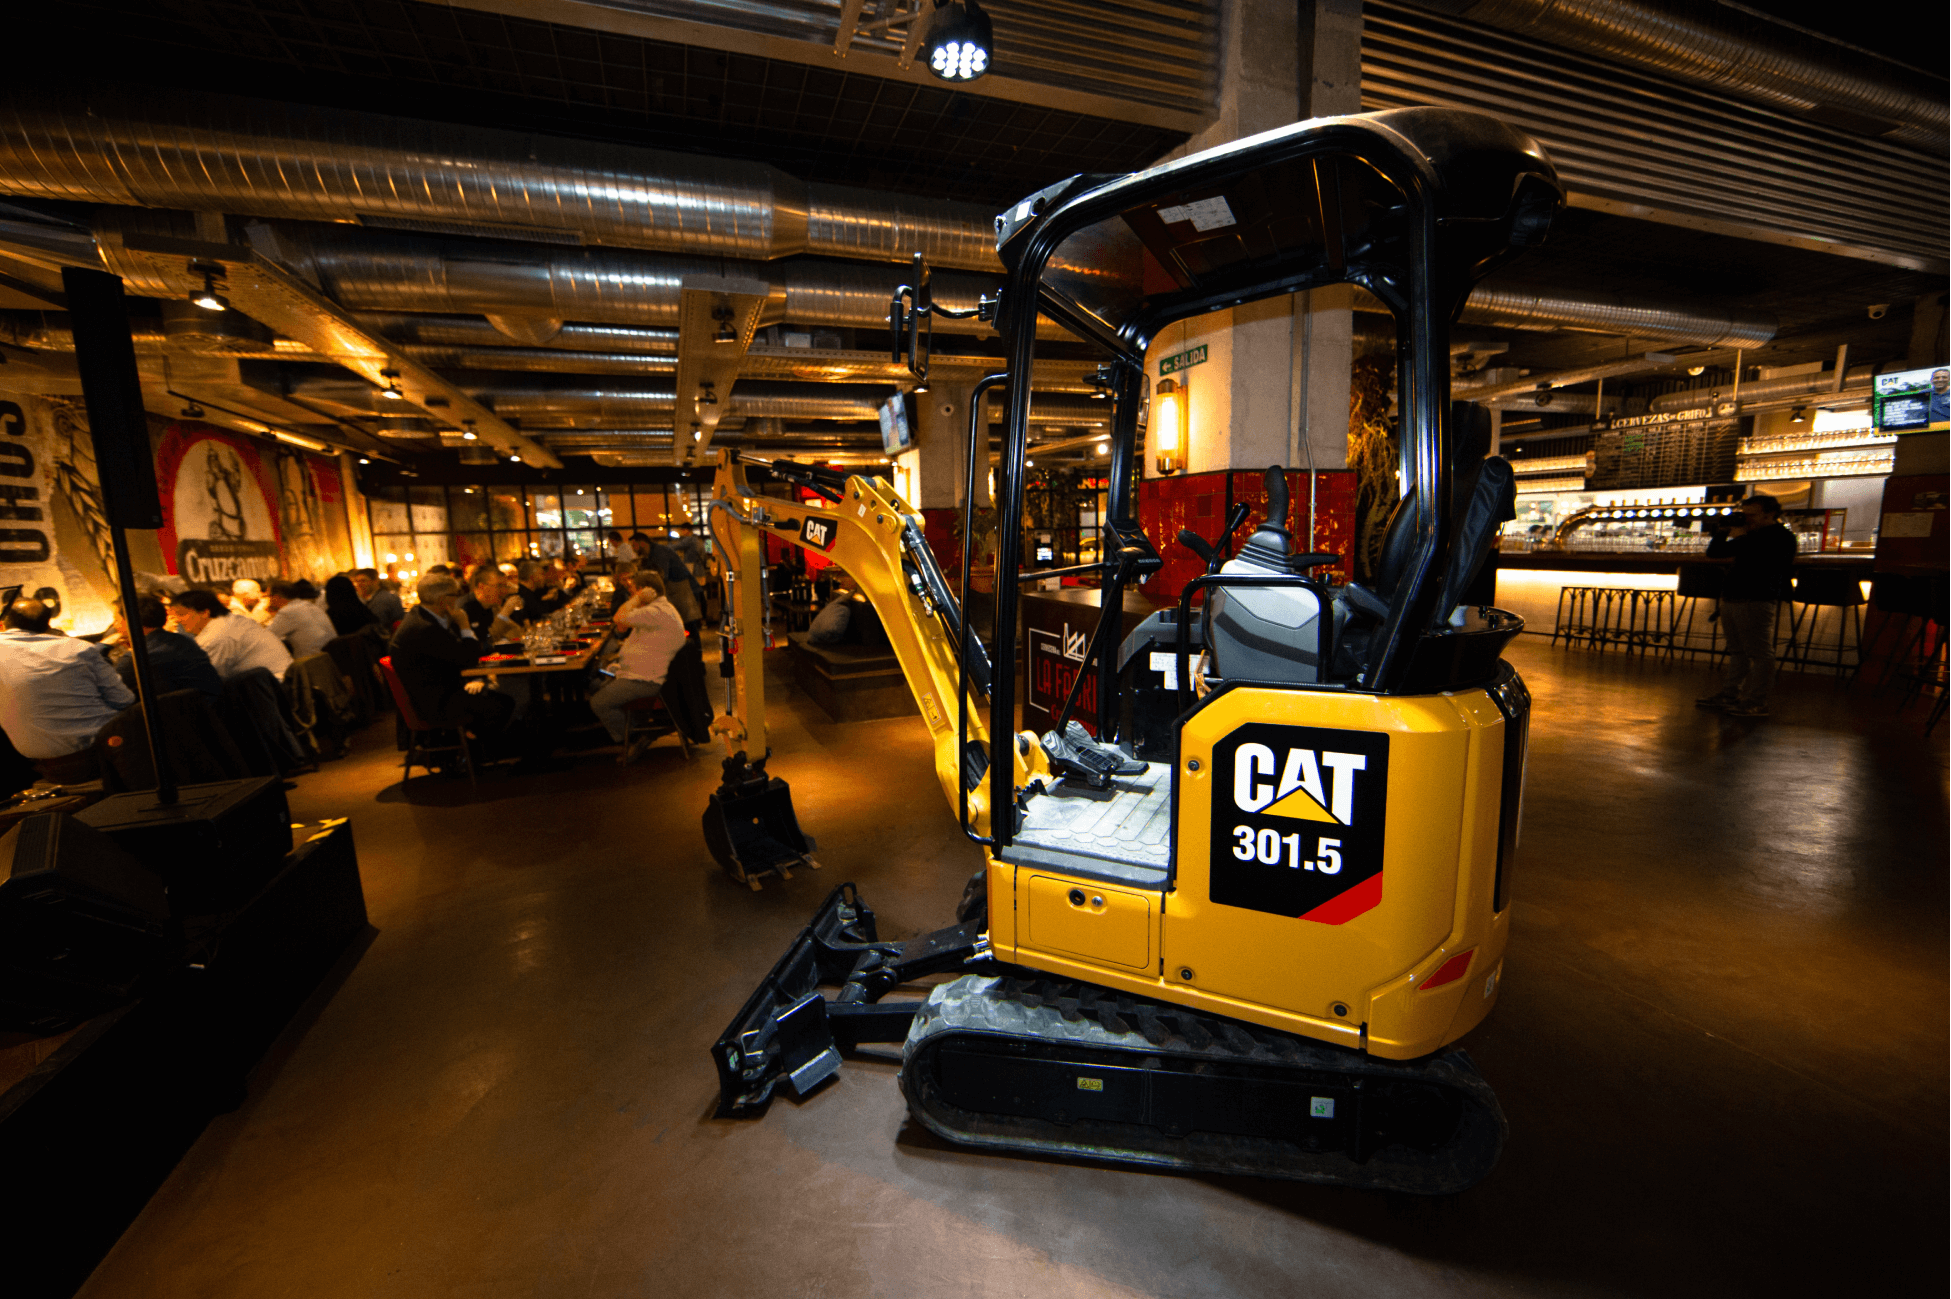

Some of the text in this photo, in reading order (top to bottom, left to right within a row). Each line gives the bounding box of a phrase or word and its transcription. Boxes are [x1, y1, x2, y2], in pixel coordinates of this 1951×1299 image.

[1174, 348, 1206, 370] SALIDA
[1882, 377, 1899, 387] CAT
[1615, 412, 1670, 429] CERVEZAS
[1677, 408, 1706, 421] GRIFO
[806, 520, 828, 547] CAT
[184, 548, 279, 584] Cruzcampo
[1036, 656, 1051, 696] LA
[1234, 742, 1368, 826] CAT
[1232, 825, 1343, 875] 301.5
